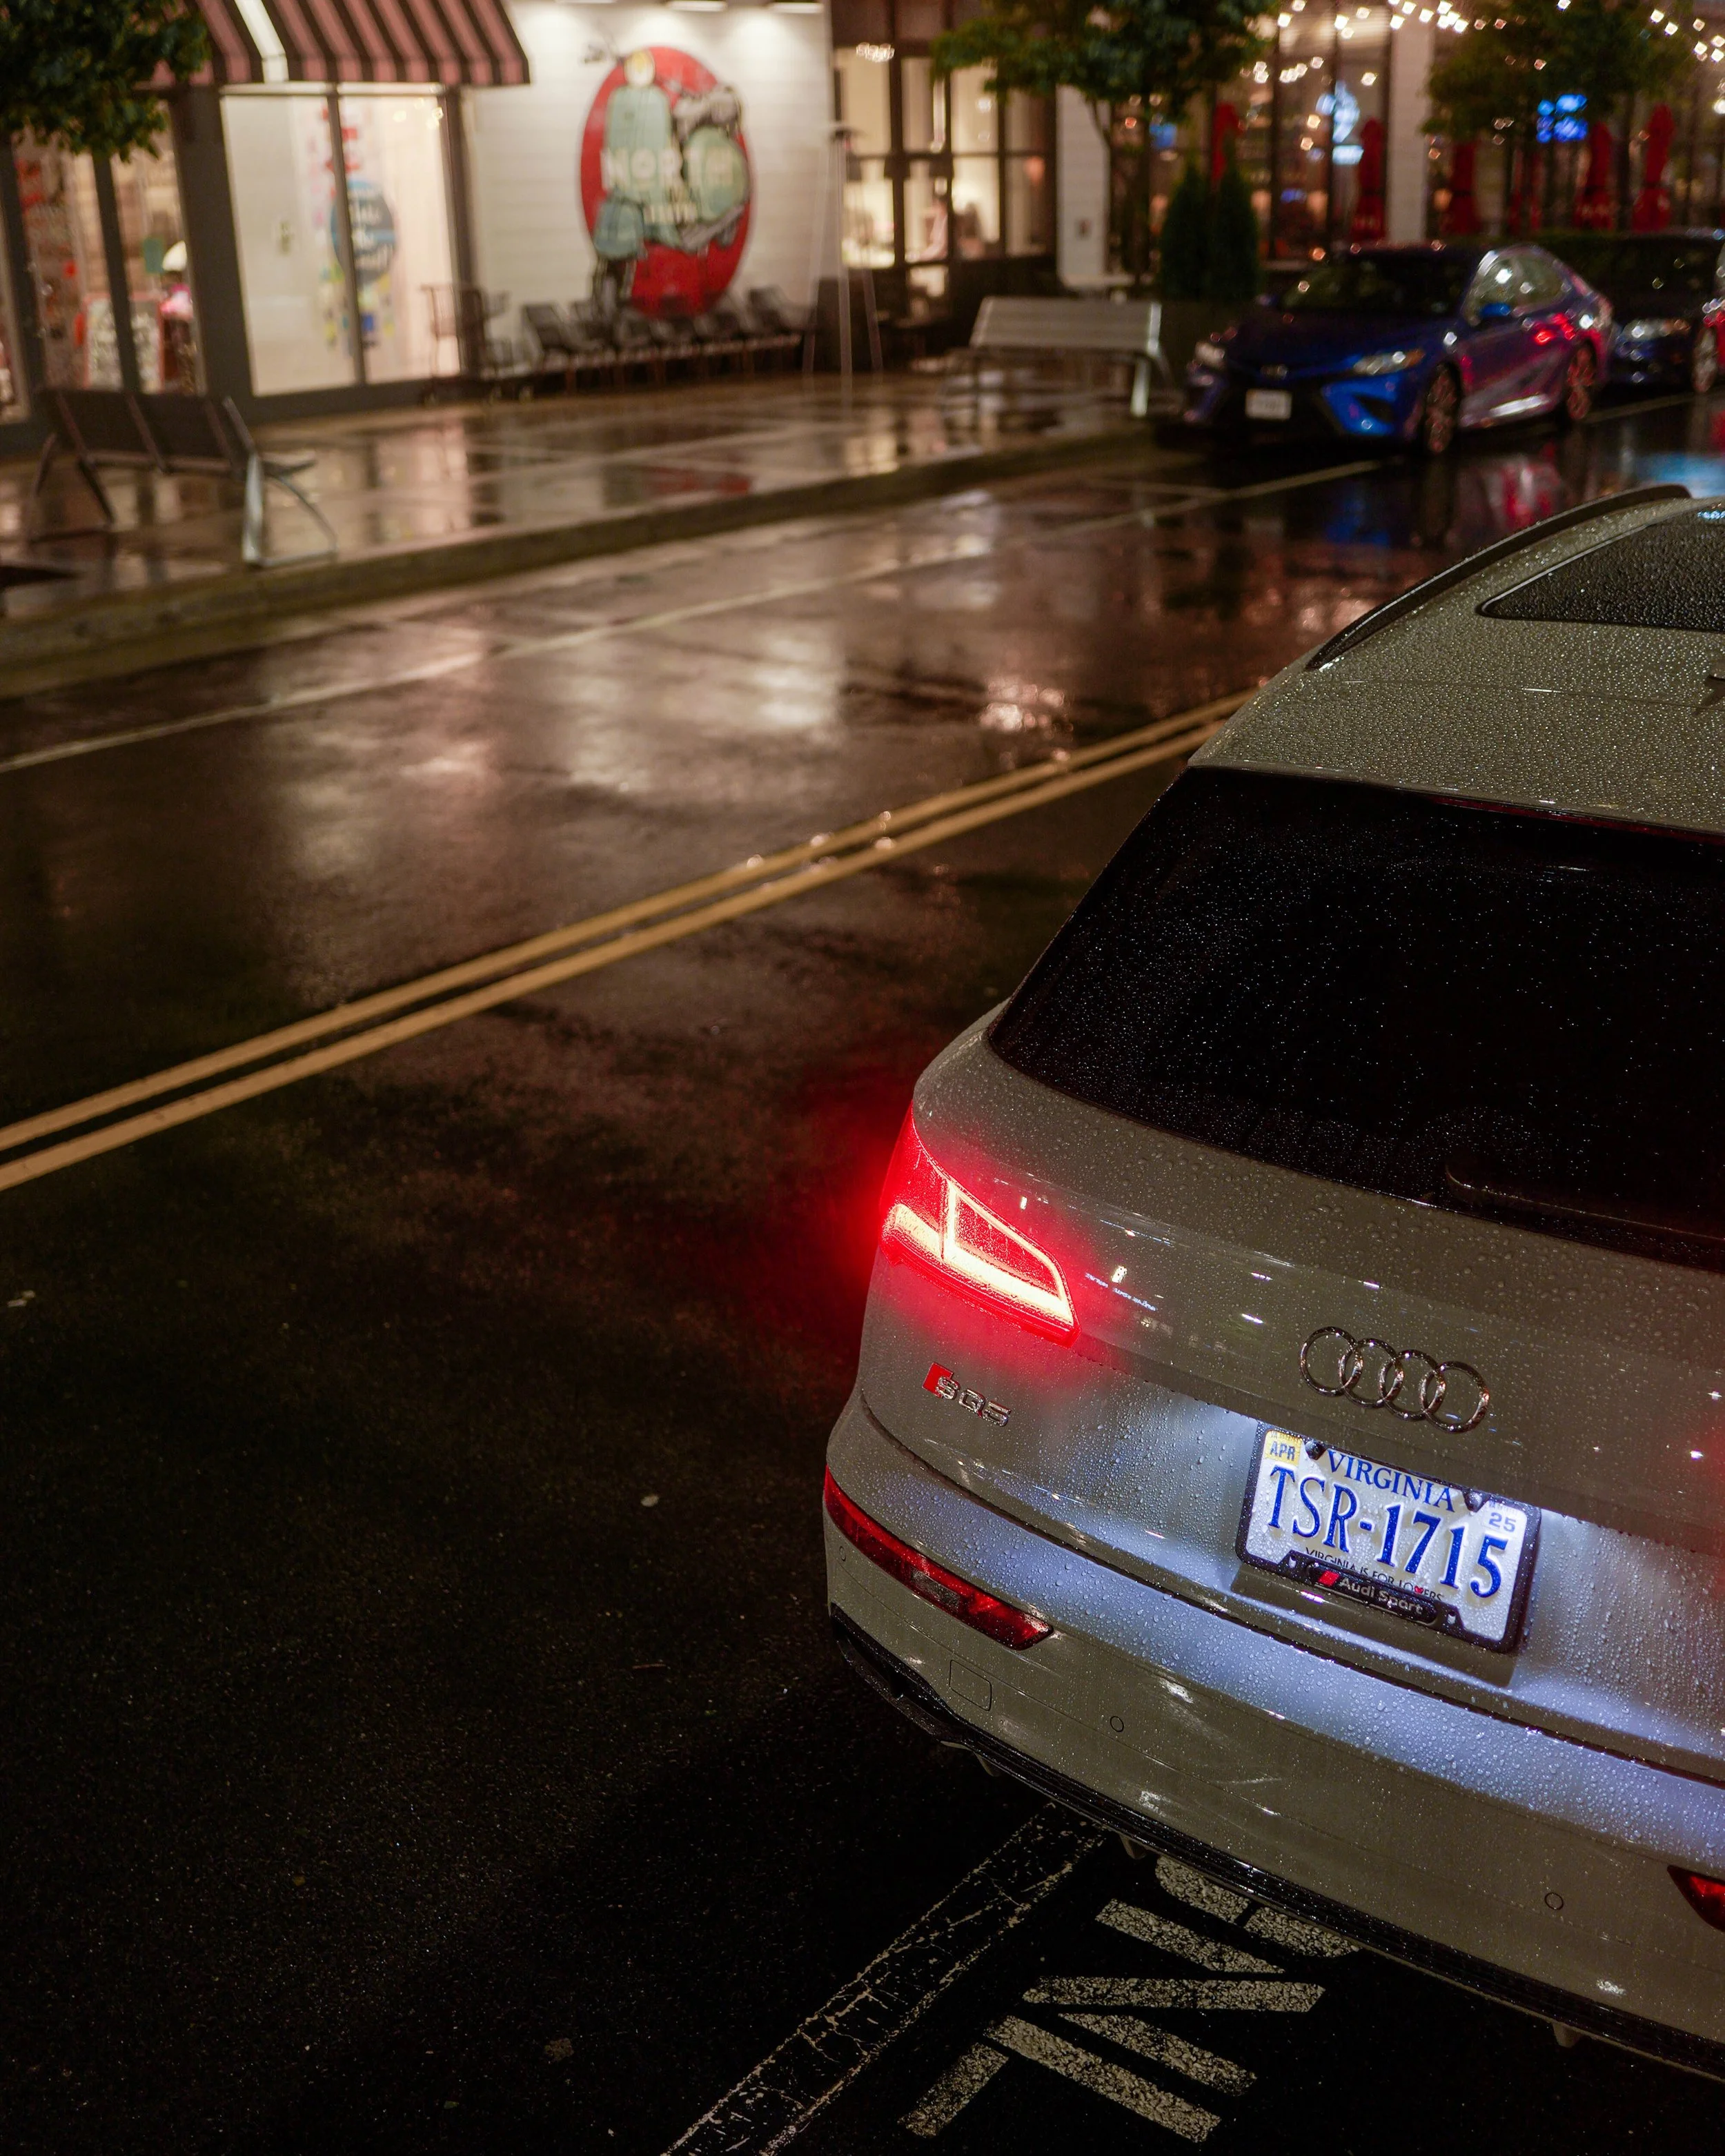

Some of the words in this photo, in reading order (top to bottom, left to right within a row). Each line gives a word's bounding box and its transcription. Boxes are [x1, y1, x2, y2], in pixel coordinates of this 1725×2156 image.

[935, 1376, 1011, 1427] SQ5
[1270, 1441, 1296, 1461] APR
[1327, 1449, 1455, 1513] VIRGINIA
[1268, 1464, 1509, 1599] TSR-1715
[1488, 1512, 1516, 1532] 25
[1306, 1546, 1357, 1572] VIRGINIA
[1360, 1566, 1369, 1576] IS
[1372, 1570, 1395, 1585] FOR
[1339, 1577, 1374, 1599] Audi
[1379, 1590, 1423, 1614] Sport
